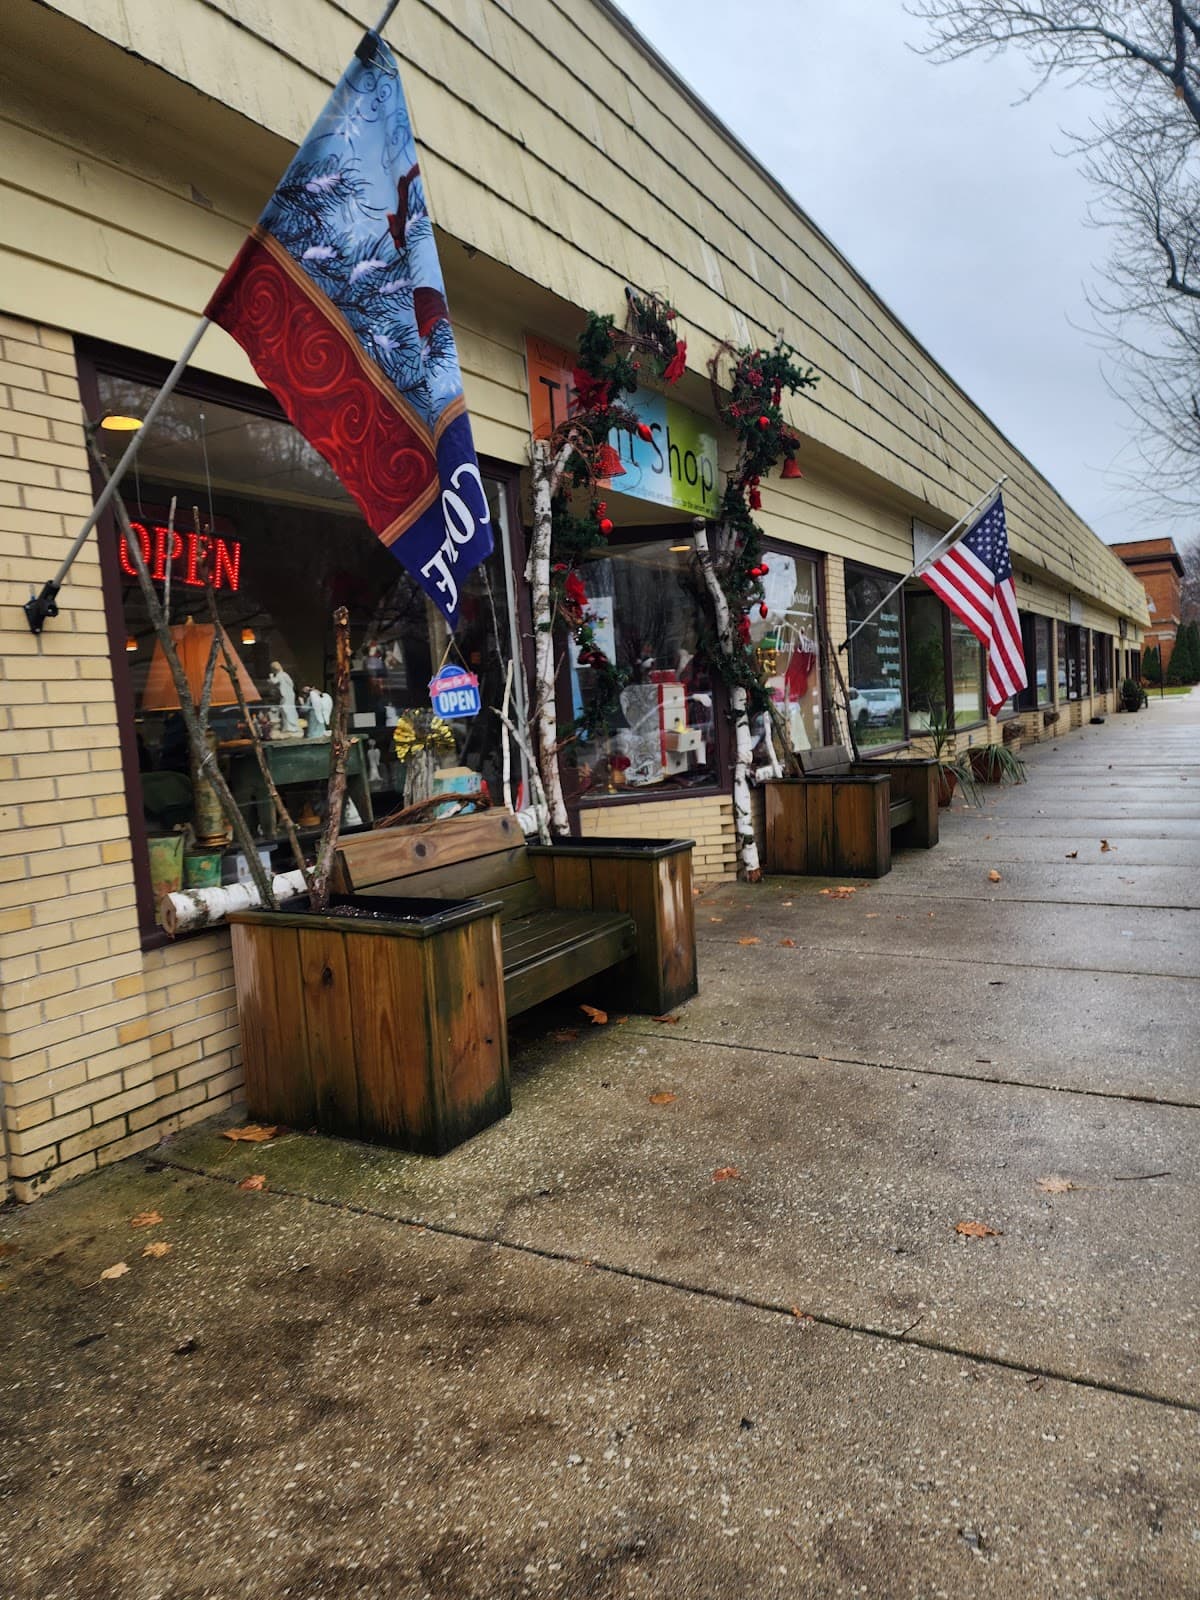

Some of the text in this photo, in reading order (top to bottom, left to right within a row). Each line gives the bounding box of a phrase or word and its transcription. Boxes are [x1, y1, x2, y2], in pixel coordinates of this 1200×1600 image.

[650, 422, 714, 504] Shop
[120, 522, 240, 591] OPEN
[439, 689, 476, 713] OPEN
